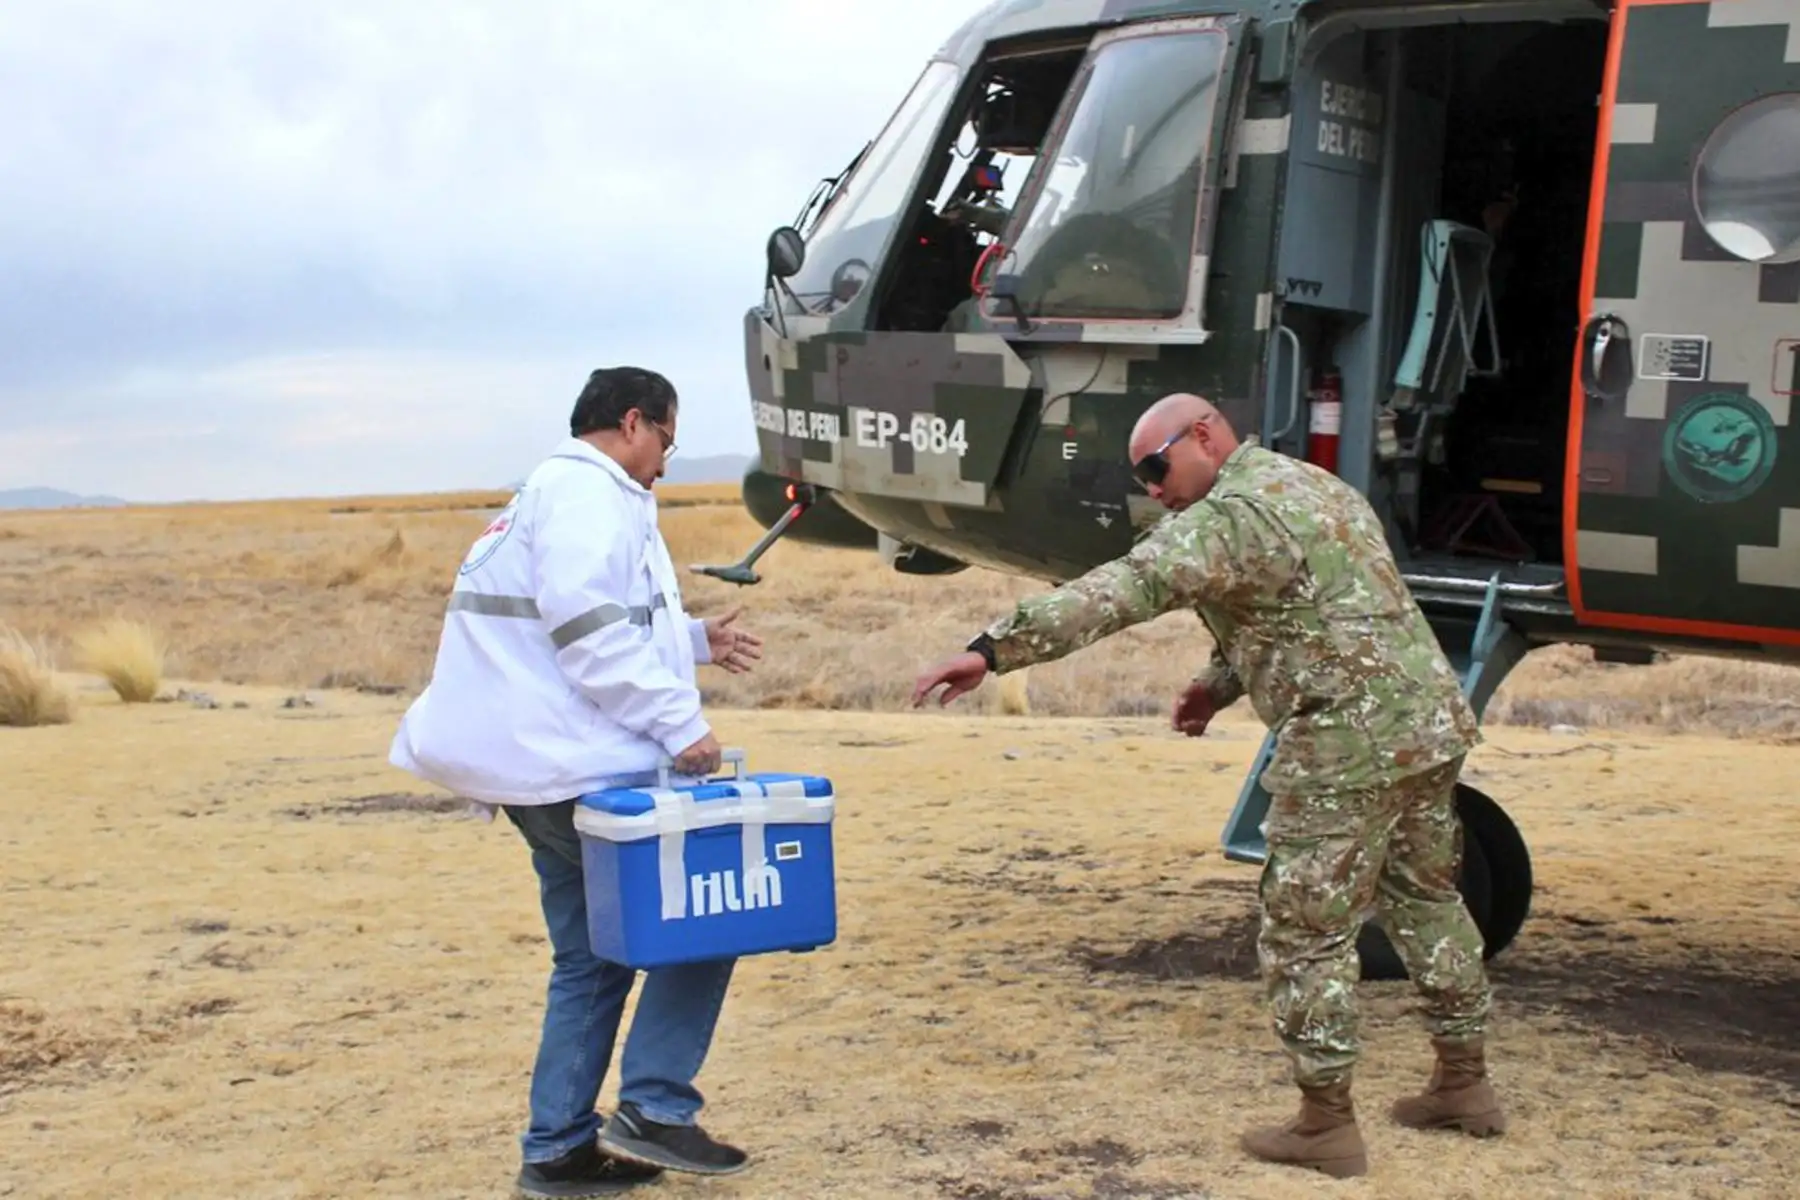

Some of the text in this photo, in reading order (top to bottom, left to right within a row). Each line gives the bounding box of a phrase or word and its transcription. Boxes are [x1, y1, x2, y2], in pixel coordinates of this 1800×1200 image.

[1320, 80, 1382, 124] EJERC
[1318, 120, 1378, 163] DEL PE
[787, 409, 809, 438] DEL
[809, 412, 840, 443] PERU
[855, 409, 969, 457] EP-684
[1062, 442, 1078, 460] E
